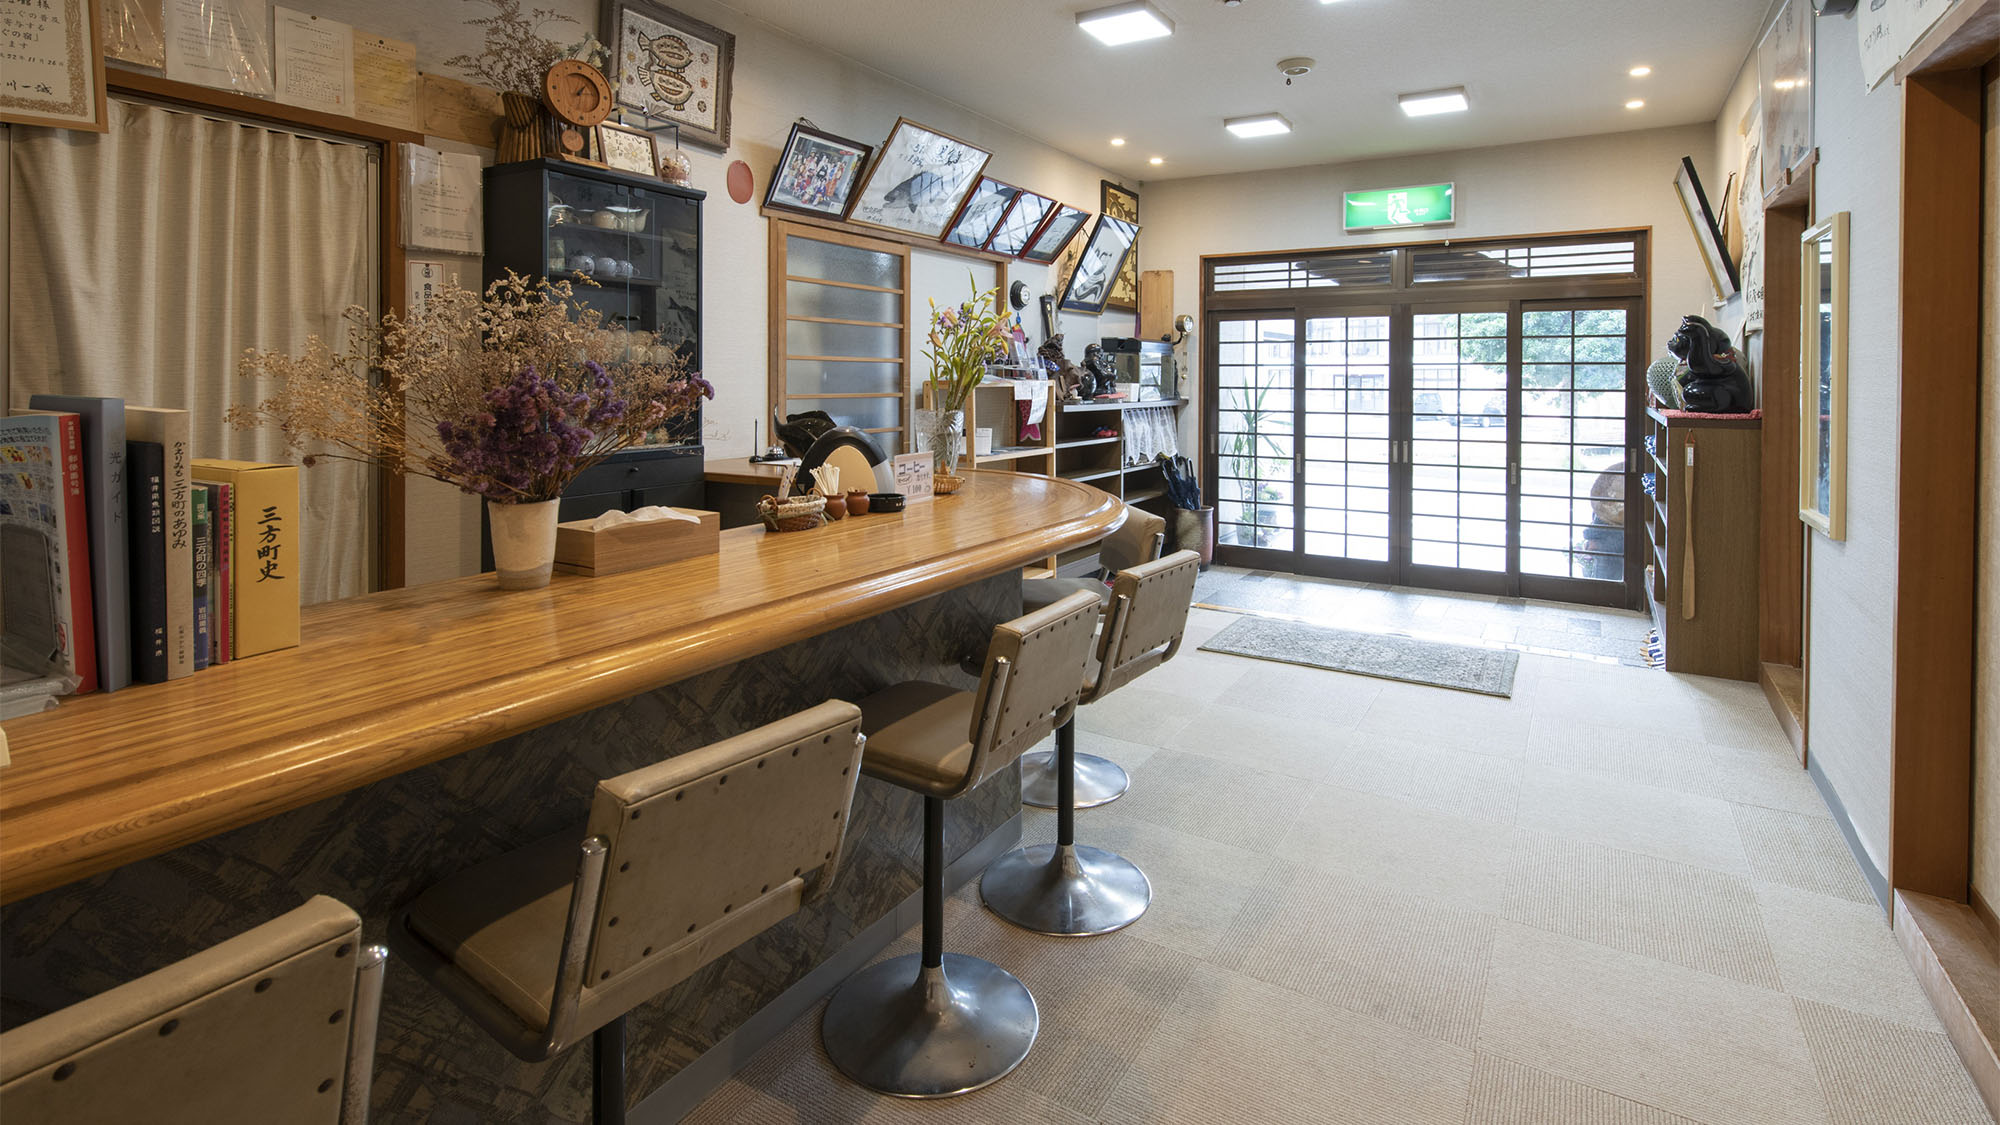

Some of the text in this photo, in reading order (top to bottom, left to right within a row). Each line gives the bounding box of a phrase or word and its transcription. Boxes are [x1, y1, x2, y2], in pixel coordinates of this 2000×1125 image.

[109, 440, 123, 525] 光ガイド
[898, 460, 926, 476] コーヒー
[195, 536, 207, 588] 三方町の四季
[256, 506, 286, 583] 三方町史
